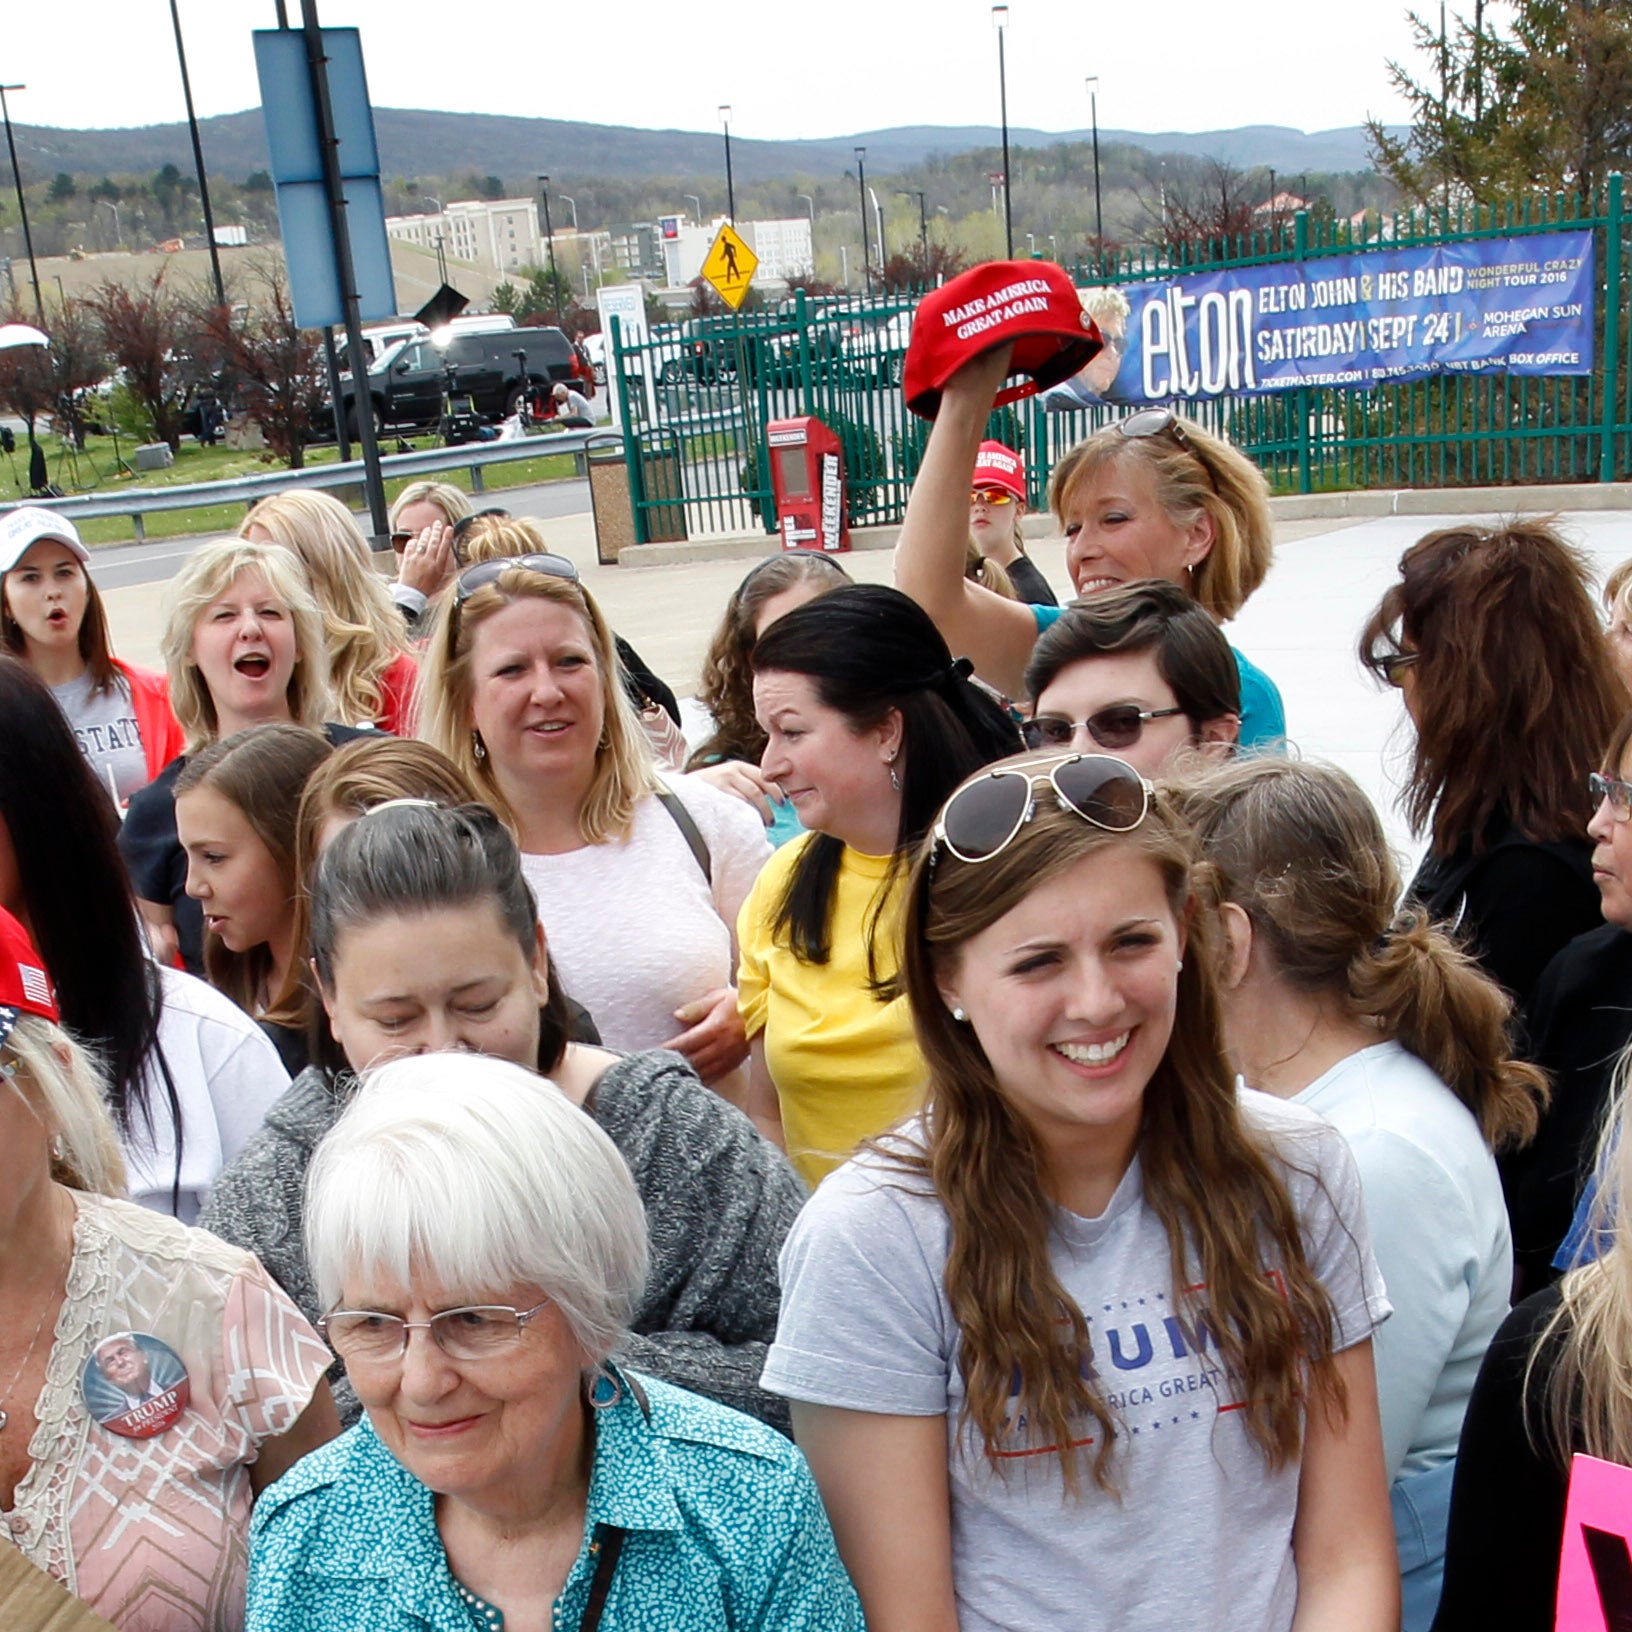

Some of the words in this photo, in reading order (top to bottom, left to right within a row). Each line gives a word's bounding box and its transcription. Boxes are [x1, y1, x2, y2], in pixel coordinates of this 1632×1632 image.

[1468, 262, 1540, 278] WONDERFUL
[1544, 258, 1583, 271] CRAZY
[1468, 276, 1501, 290] NIGHT
[1504, 273, 1537, 287] TOUR
[1540, 271, 1567, 284] 2016
[942, 297, 986, 327] MAKE
[985, 279, 1052, 310] AMERICA
[1259, 283, 1306, 313] ELTON
[1311, 277, 1357, 309] JOHN
[1360, 275, 1373, 301] &
[1414, 266, 1465, 297] BAND
[957, 308, 1004, 340] GREAT
[1003, 297, 1049, 319] AGAIN
[1482, 322, 1528, 339] ARENA
[1483, 307, 1549, 325] MOHEGAN
[1552, 304, 1582, 319] SUN
[1142, 286, 1255, 399] elton
[1257, 320, 1357, 362] SATURDAY
[1368, 314, 1418, 352] SEPT
[1422, 311, 1453, 347] 24
[1260, 371, 1362, 389] TICKETMASTER.COM
[1471, 356, 1507, 371] BANK
[1509, 354, 1534, 365] BOX
[1536, 352, 1580, 365] OFFICE
[822, 453, 839, 550] WEEKENDER
[1159, 1369, 1219, 1399] GREAT
[122, 1391, 178, 1427] TRUMP
